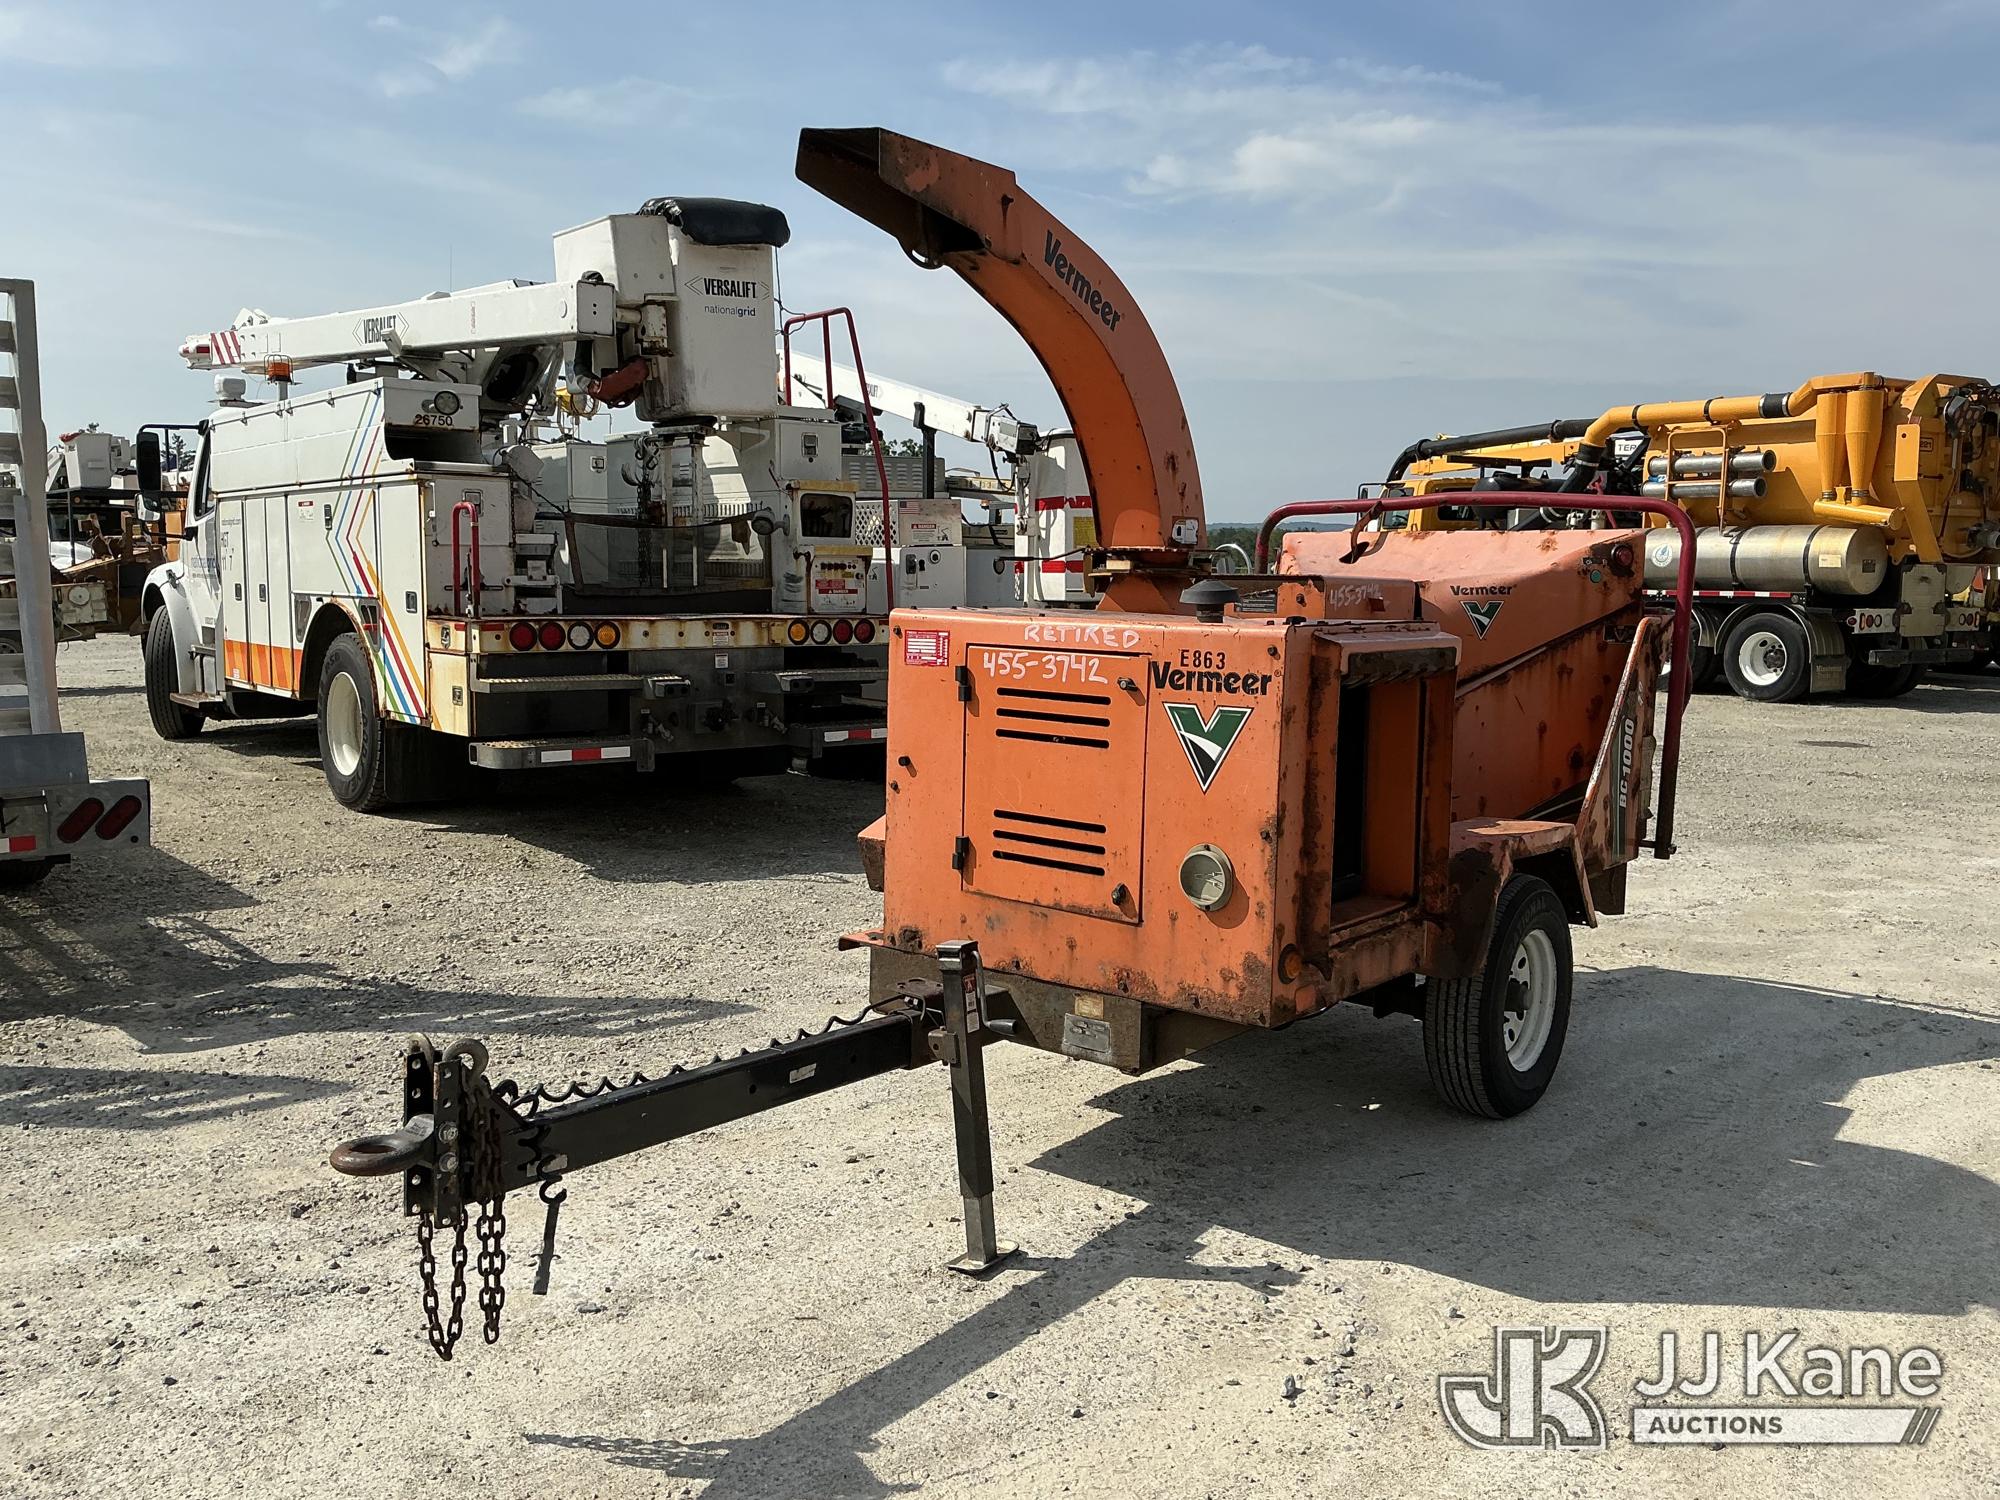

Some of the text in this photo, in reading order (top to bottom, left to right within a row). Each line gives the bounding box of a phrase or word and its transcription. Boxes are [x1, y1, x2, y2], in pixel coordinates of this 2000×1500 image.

[703, 277, 758, 299] VERSALIFT
[1045, 229, 1121, 332] Vermeer
[704, 304, 756, 317] nationalgrid
[414, 414, 453, 426] 26750
[1450, 585, 1512, 596] Vermeer
[1024, 624, 1139, 648] RETIRED
[983, 651, 1108, 684] 455-3742
[1180, 650, 1226, 669] E863
[1152, 661, 1272, 695] Vermeer
